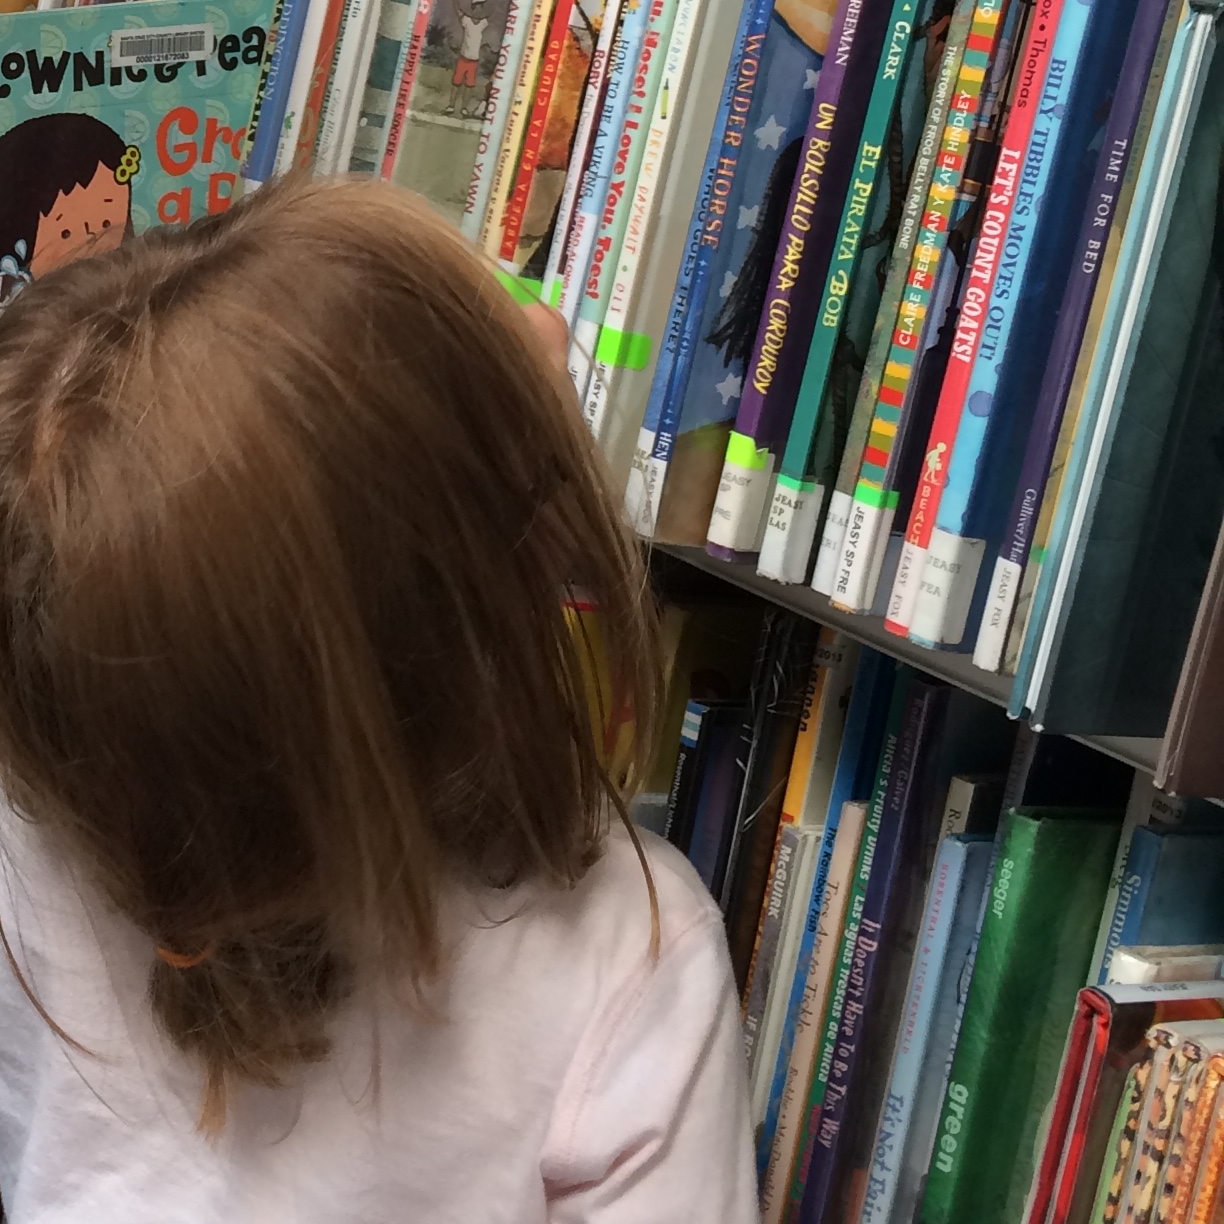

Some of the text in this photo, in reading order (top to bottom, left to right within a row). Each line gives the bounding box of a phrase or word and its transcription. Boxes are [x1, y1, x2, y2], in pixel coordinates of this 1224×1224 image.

[403, 35, 421, 77] HAPPY
[882, 20, 911, 80] CLARK
[947, 45, 958, 66] THE
[1016, 36, 1047, 108] Thomas
[398, 81, 409, 109] LIKE
[723, 33, 766, 147] WONDER
[931, 107, 941, 122] OF
[937, 68, 951, 104] STORY
[1038, 58, 1068, 123] BILLY
[387, 113, 403, 156] SOCCER
[815, 102, 838, 131] UN
[923, 125, 935, 156] FROG
[790, 136, 831, 233] BOLSILLO
[858, 141, 882, 174] EL
[914, 158, 928, 193] BELLY
[990, 147, 1021, 207] LET'S
[1015, 126, 1051, 217] TIBBLES
[700, 156, 737, 250] HORSE
[838, 178, 873, 261] PIRATA
[898, 90, 972, 346] CLAIRE FREEDMAN KATE HINDLEY
[908, 195, 919, 217] RAT
[1081, 138, 1128, 274] TIME FOR BED
[776, 232, 805, 291] PARA
[898, 219, 913, 250] BONE
[970, 208, 1006, 284] COUNT
[994, 223, 1025, 300] MOVES
[822, 270, 849, 328] BOB
[951, 287, 987, 363] GOATS!
[752, 297, 791, 396] CORDUROY
[979, 305, 1005, 361] OUT!
[909, 486, 931, 546] BEACH
[766, 844, 792, 918] McGUIRK
[992, 859, 1015, 919] seeger
[936, 1081, 971, 1175] green
